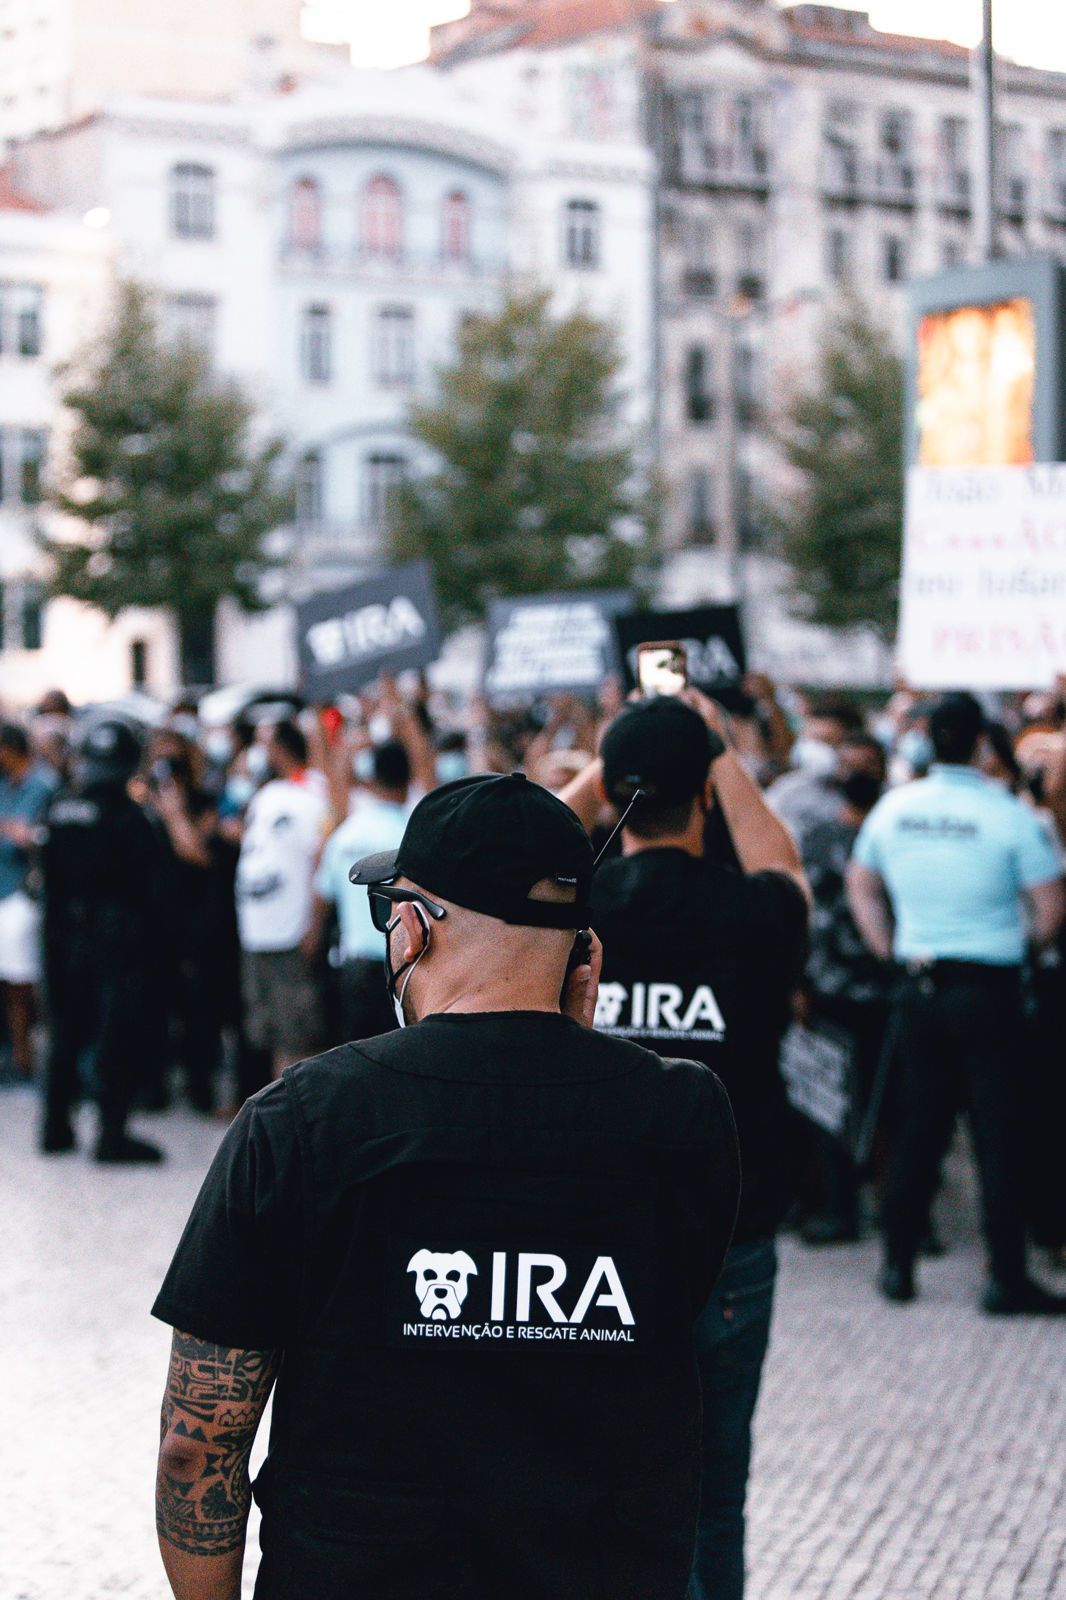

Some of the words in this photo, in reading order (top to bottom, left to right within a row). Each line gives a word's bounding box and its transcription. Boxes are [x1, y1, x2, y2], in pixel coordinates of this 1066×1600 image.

[343, 595, 427, 658] IRA
[631, 981, 727, 1032] IRA
[490, 1251, 636, 1326] IRA
[403, 1322, 503, 1340] INTERVENÇÃO
[506, 1325, 515, 1339] E
[517, 1326, 577, 1340] RESGATE
[579, 1328, 635, 1342] ANIMAL
